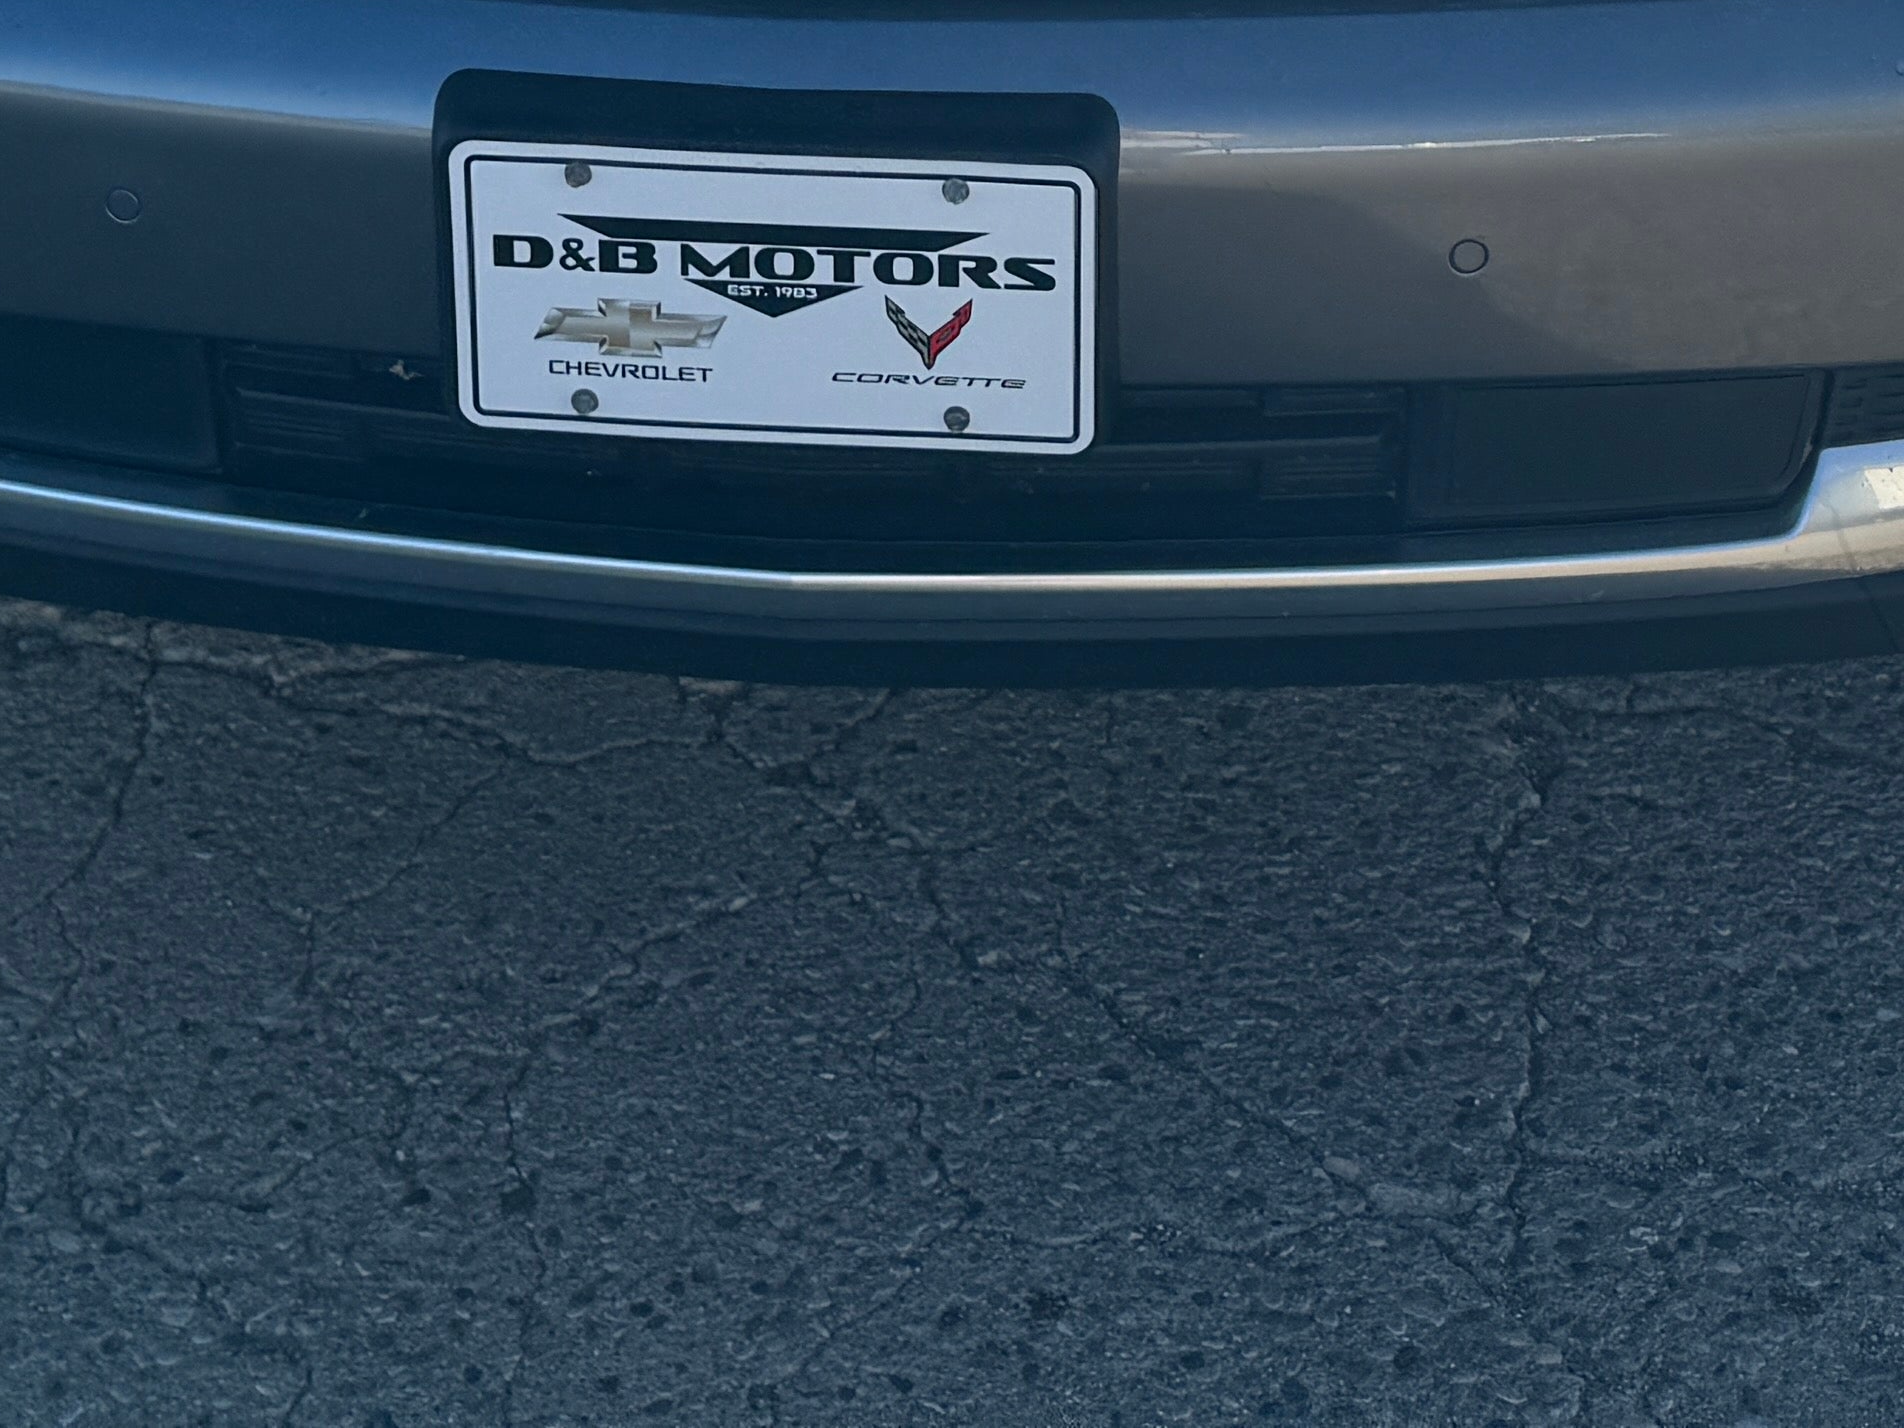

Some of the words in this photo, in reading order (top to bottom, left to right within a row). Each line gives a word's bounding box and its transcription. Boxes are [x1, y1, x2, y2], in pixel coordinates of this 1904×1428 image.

[492, 233, 658, 274] D&B
[680, 243, 1057, 293] MOTORS
[726, 284, 768, 297] EST.
[548, 359, 714, 384] CHEVROLET
[831, 371, 1027, 389] CORVETTE
